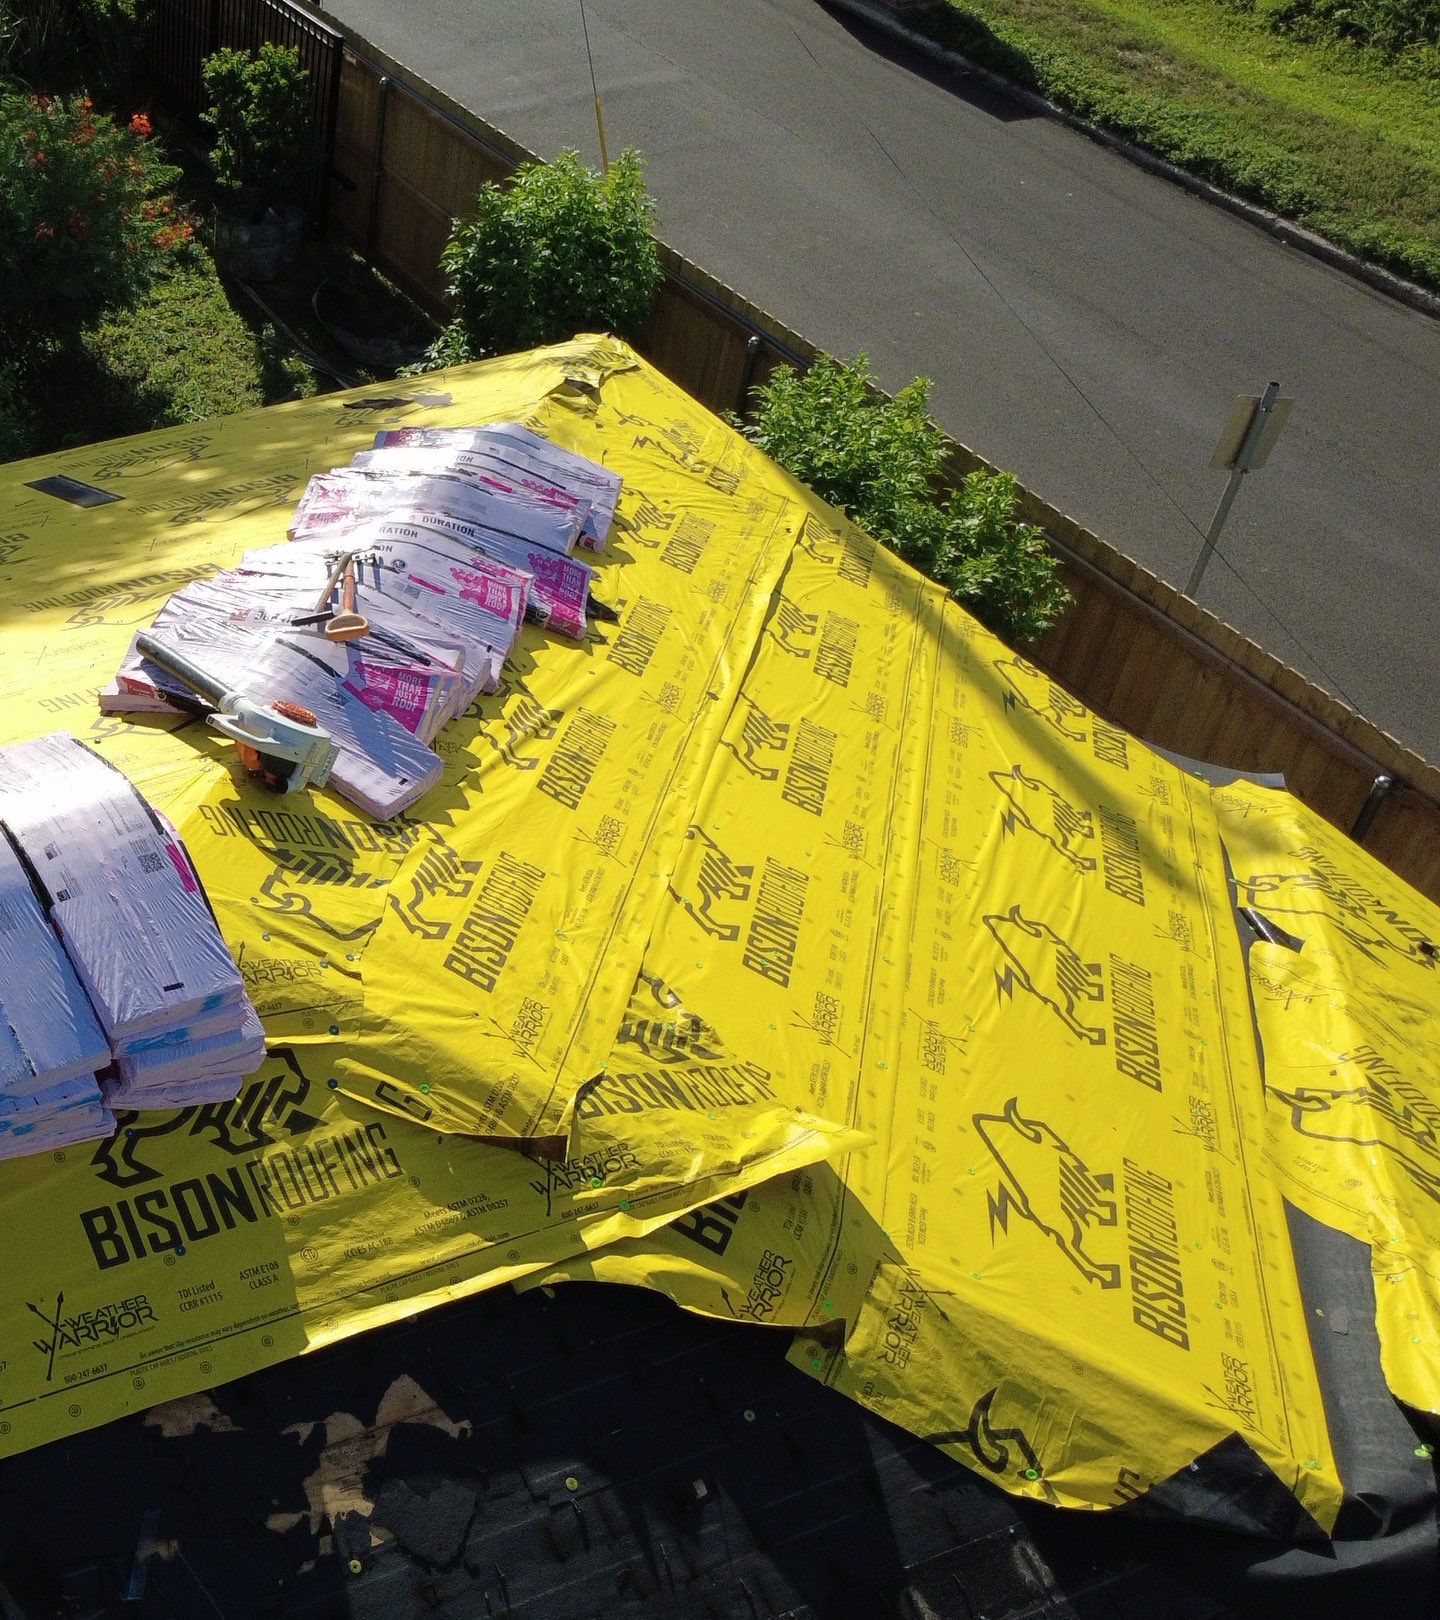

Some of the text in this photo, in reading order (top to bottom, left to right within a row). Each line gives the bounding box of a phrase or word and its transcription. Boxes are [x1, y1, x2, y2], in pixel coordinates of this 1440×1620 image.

[421, 515, 475, 538] DURATION
[398, 671, 425, 687] MORE
[396, 681, 424, 698] THAN
[391, 695, 420, 712] ROOF
[242, 966, 328, 986] ARRIOR
[414, 1221, 436, 1237] ASTM
[466, 1205, 488, 1219] ASTM
[239, 1267, 260, 1281] ASTM
[249, 1277, 273, 1291] CLASS
